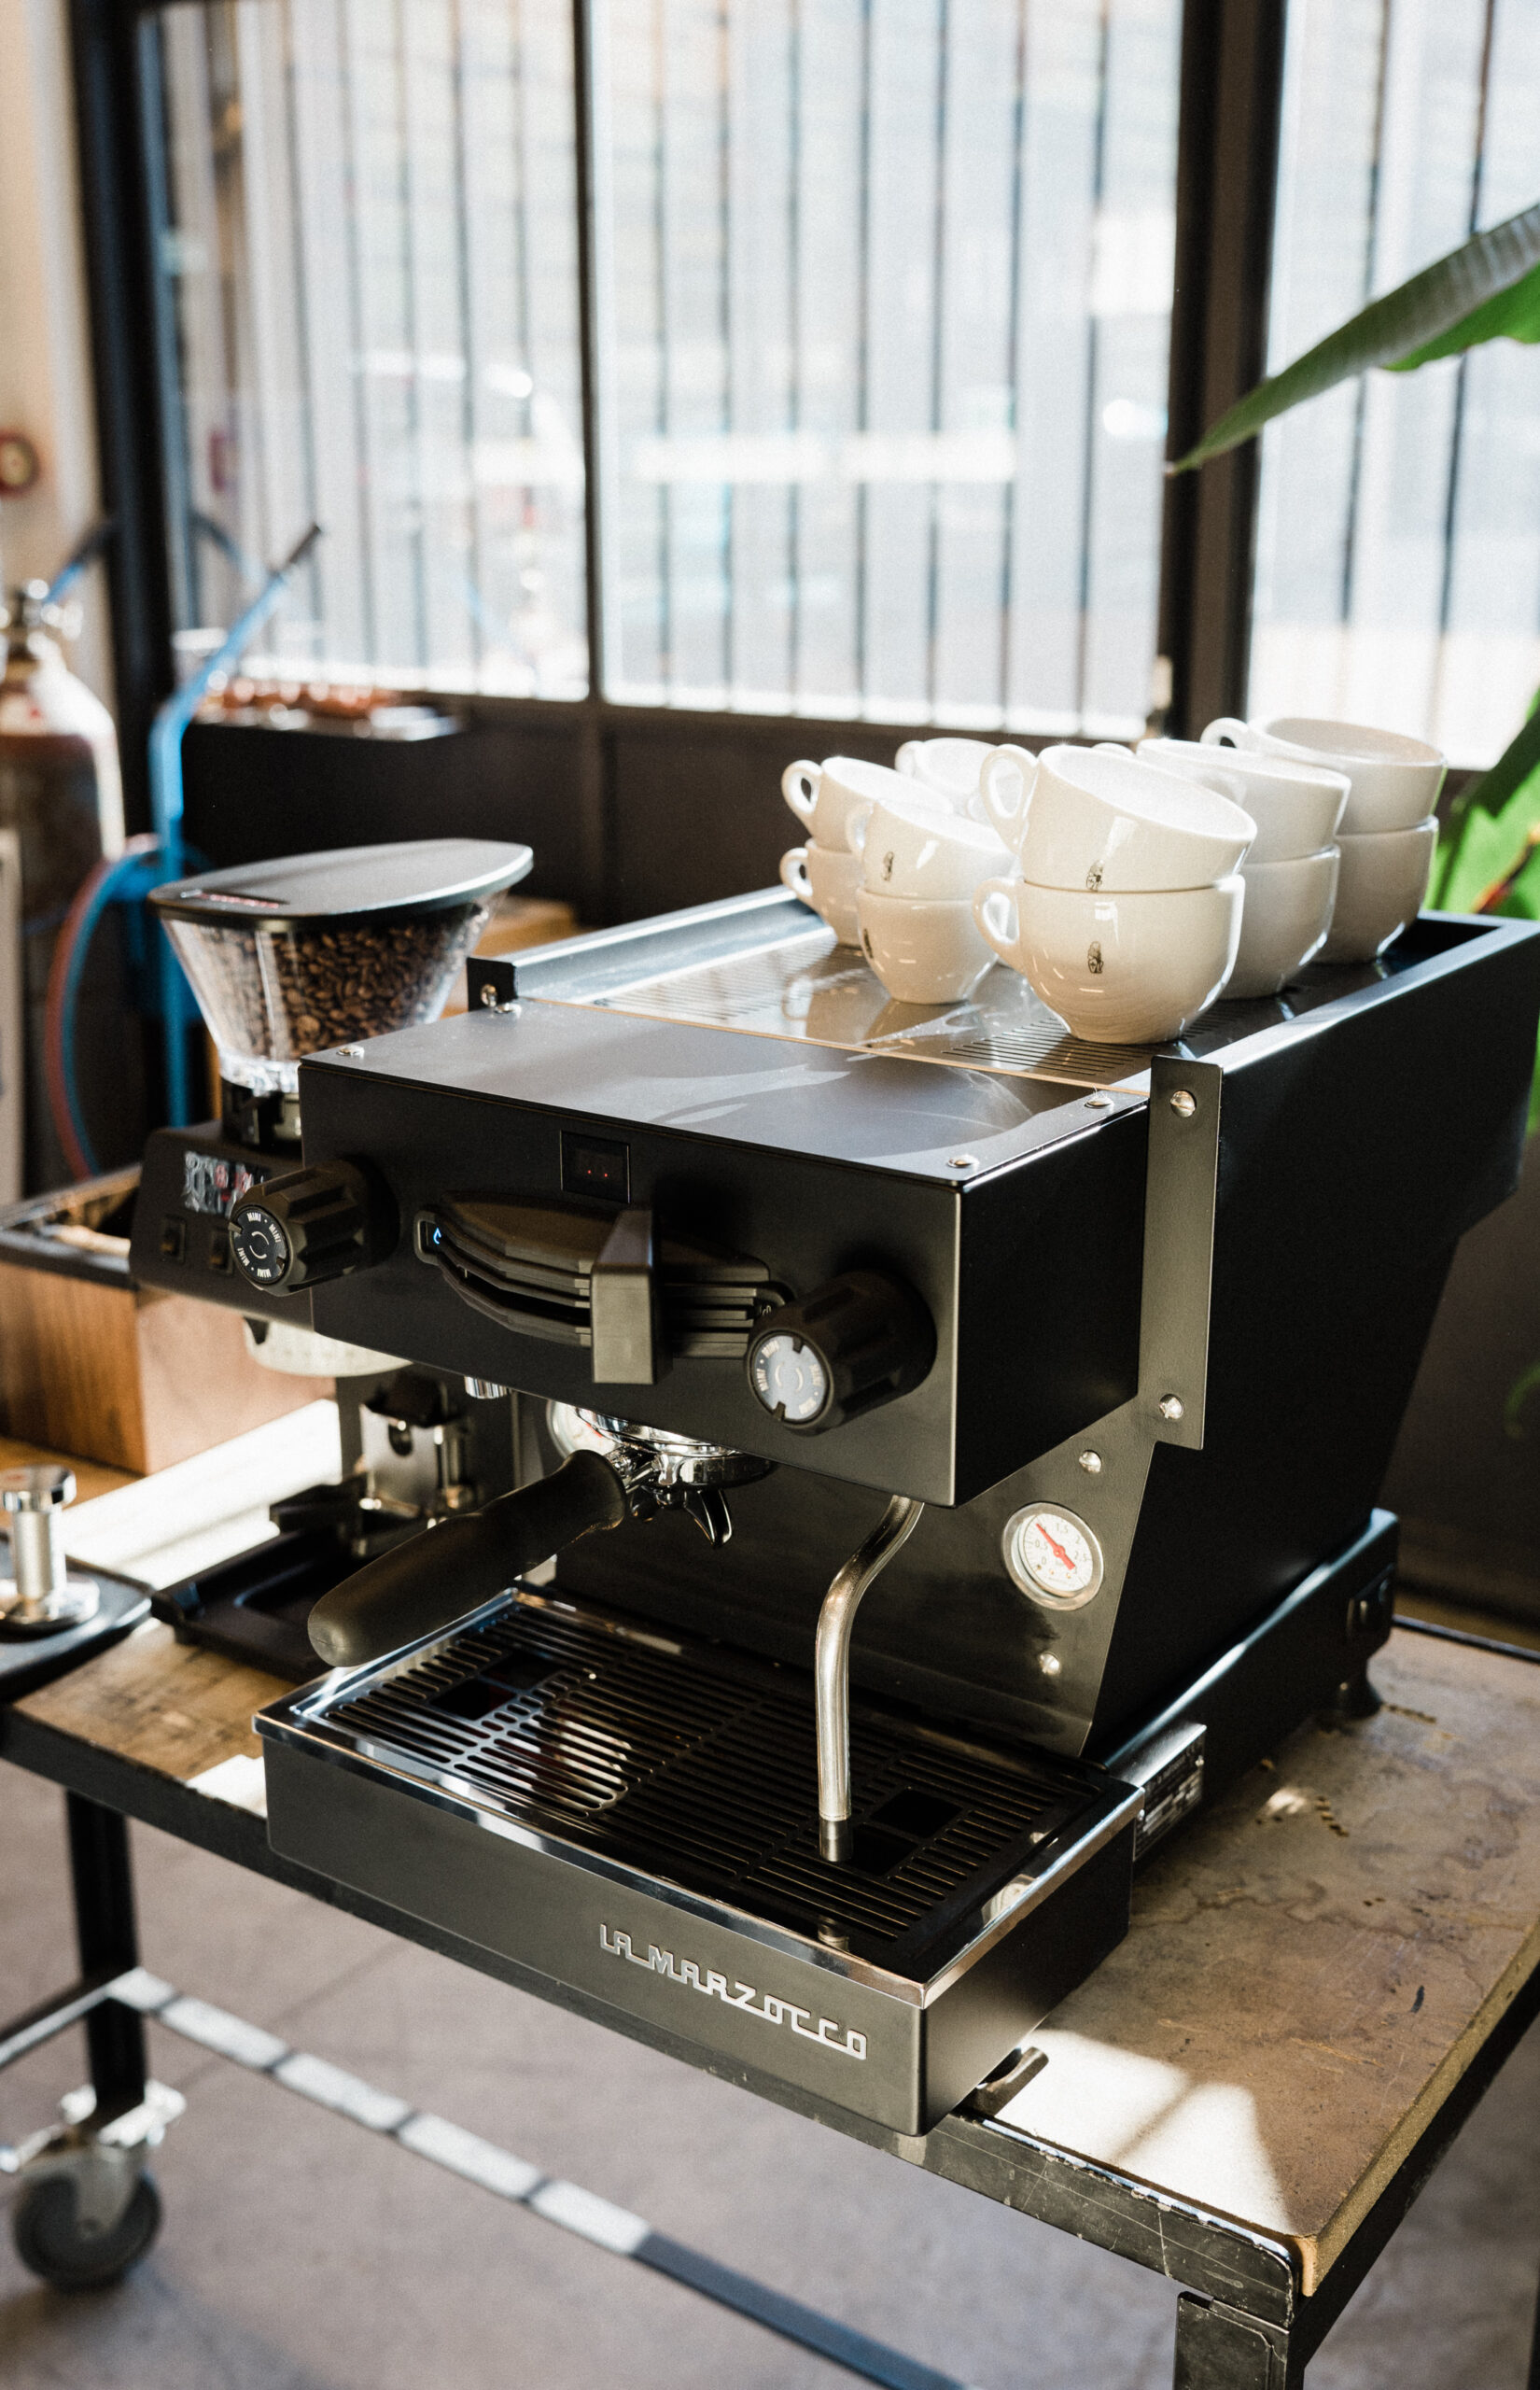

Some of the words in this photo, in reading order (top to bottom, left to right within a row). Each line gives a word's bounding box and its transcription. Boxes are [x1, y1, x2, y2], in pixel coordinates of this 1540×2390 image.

[268, 1223, 281, 1243] MINI
[237, 1247, 250, 1267] MINI
[756, 1368, 769, 1392] MINI
[1041, 1555, 1047, 1565] 0
[599, 1923, 638, 1962] LA
[648, 1944, 868, 2060] MARZOCCO
